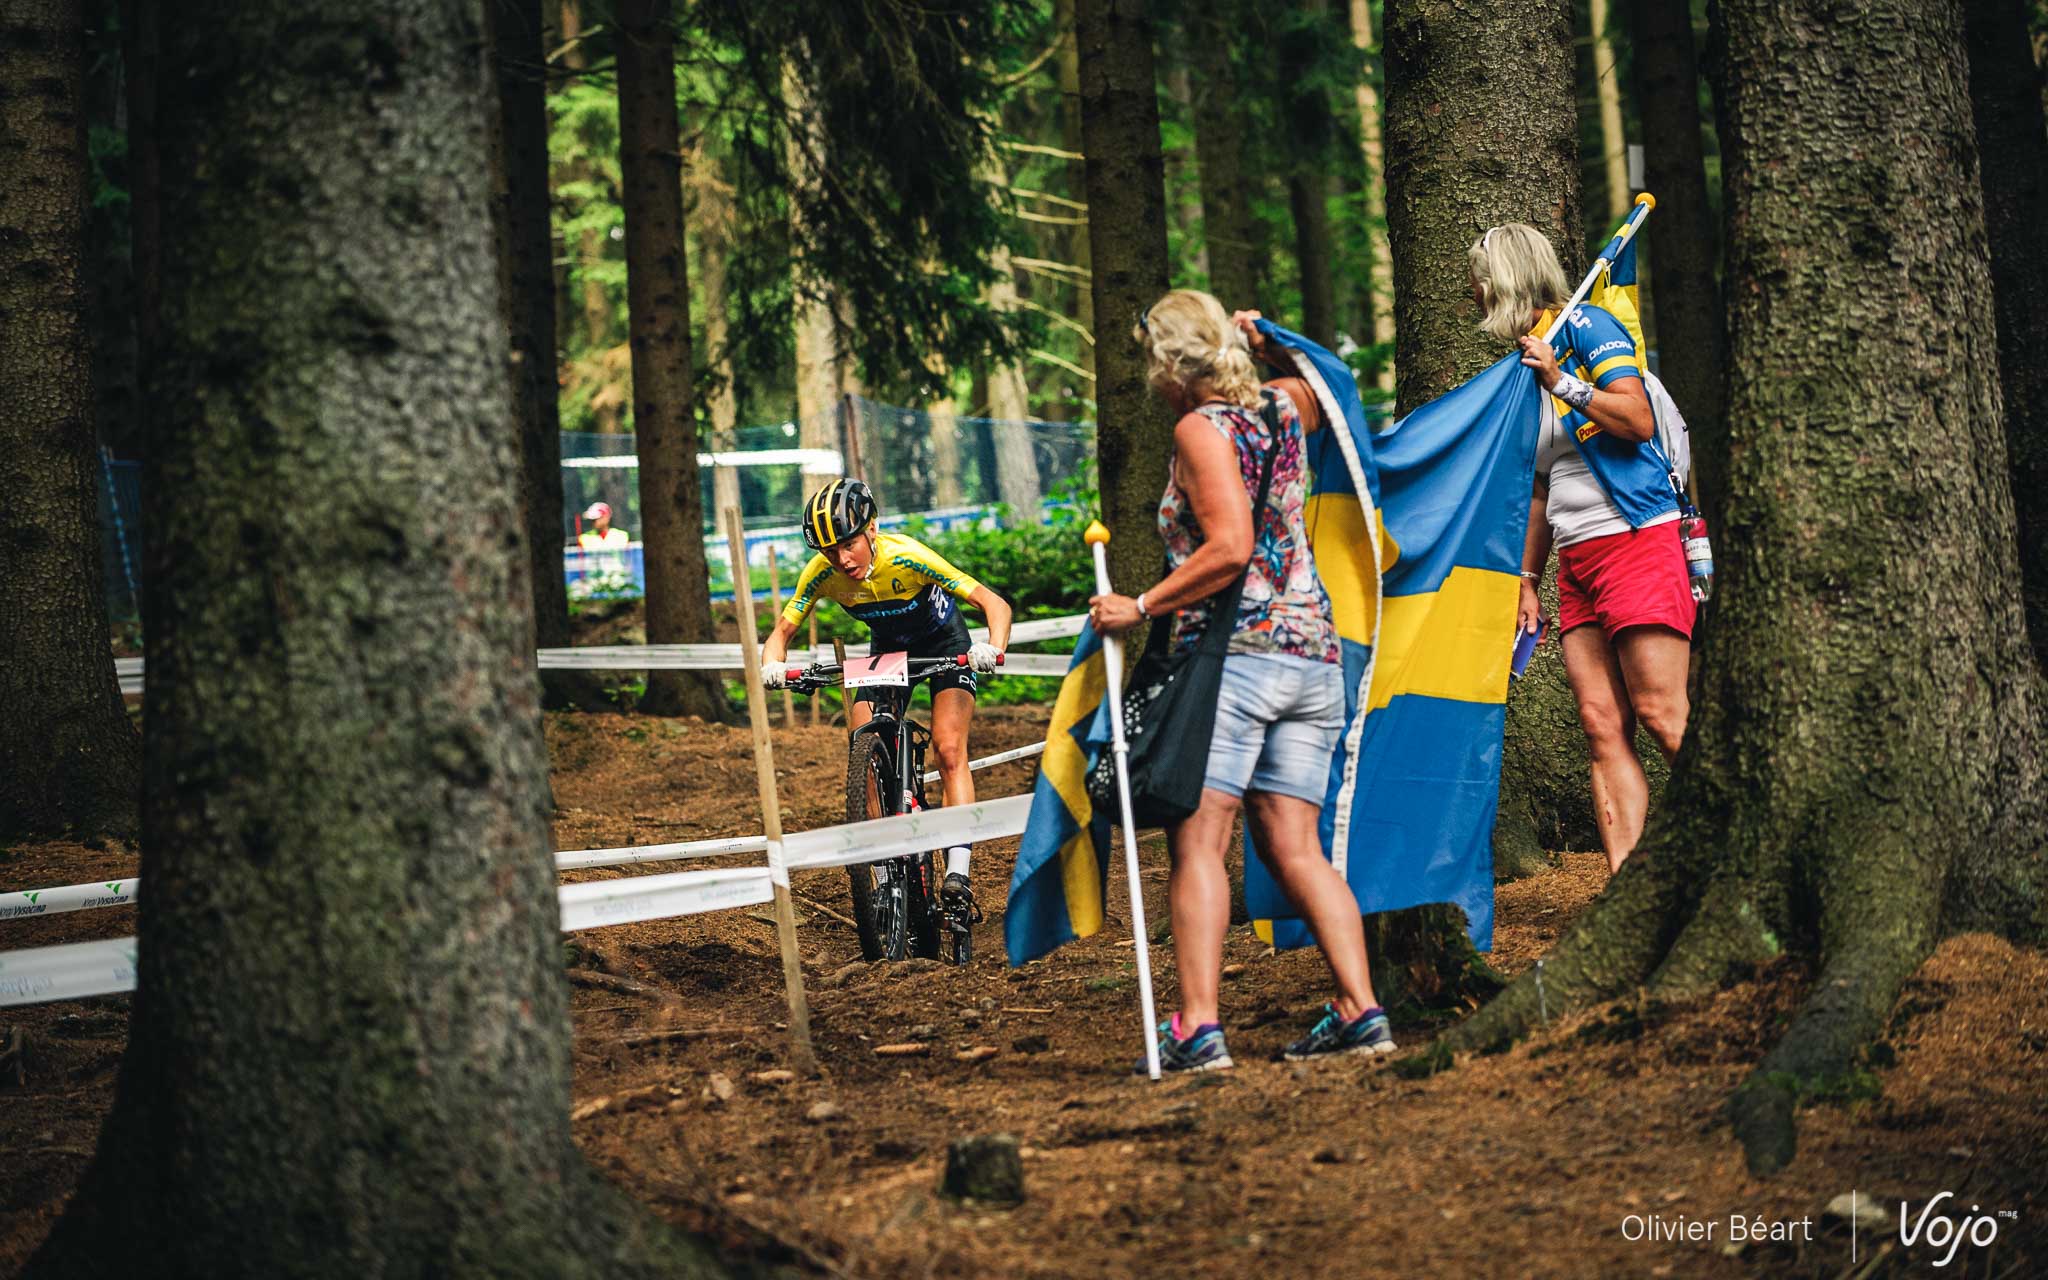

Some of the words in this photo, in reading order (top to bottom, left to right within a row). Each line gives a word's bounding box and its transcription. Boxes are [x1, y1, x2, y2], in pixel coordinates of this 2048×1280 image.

[1589, 340, 1633, 361] DIADORA
[892, 555, 959, 591] postnord
[795, 566, 833, 612] postnor
[853, 600, 918, 618] ostnord
